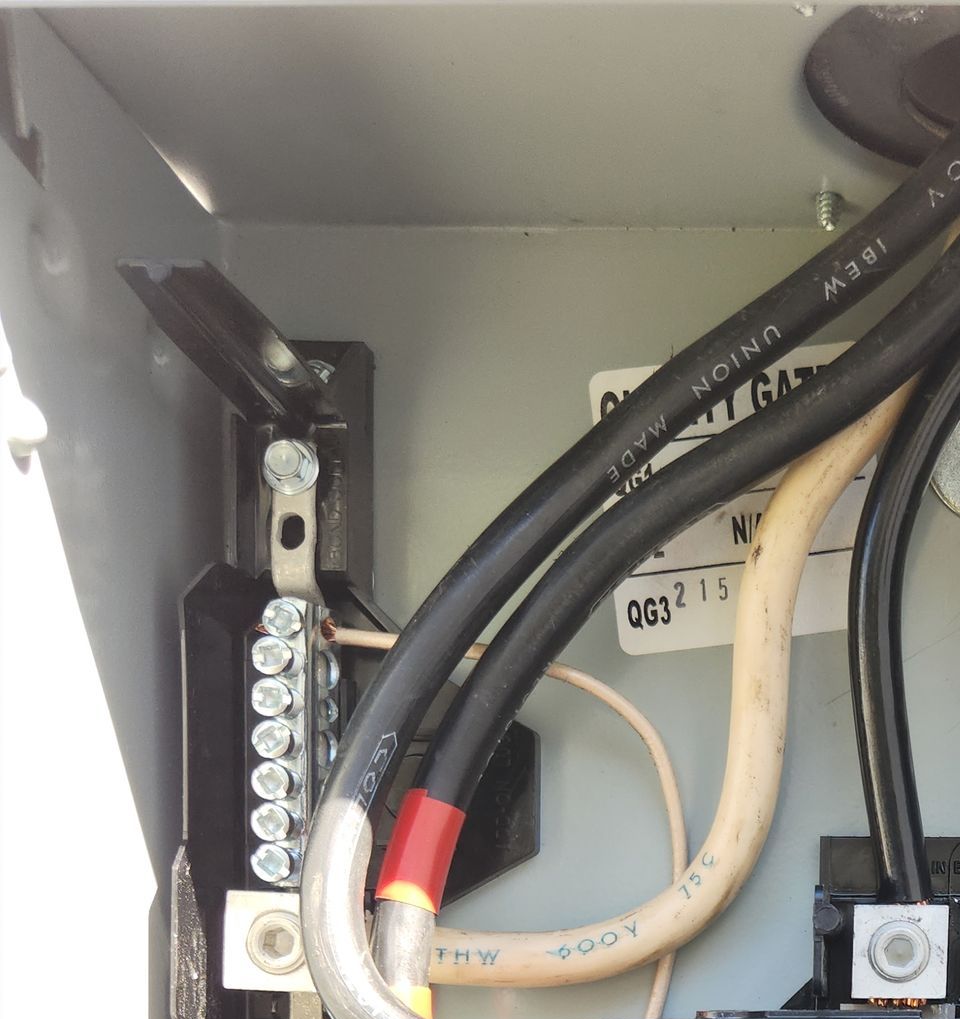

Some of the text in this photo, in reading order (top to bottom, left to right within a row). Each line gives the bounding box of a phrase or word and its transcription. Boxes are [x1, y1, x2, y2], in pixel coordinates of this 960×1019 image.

[822, 238, 888, 301] IBEW
[691, 325, 782, 400] UNION
[607, 413, 669, 484] MADE
[627, 596, 672, 630] QG3
[930, 860, 946, 874] IN
[436, 948, 500, 966] THW
[556, 920, 640, 961] 600V
